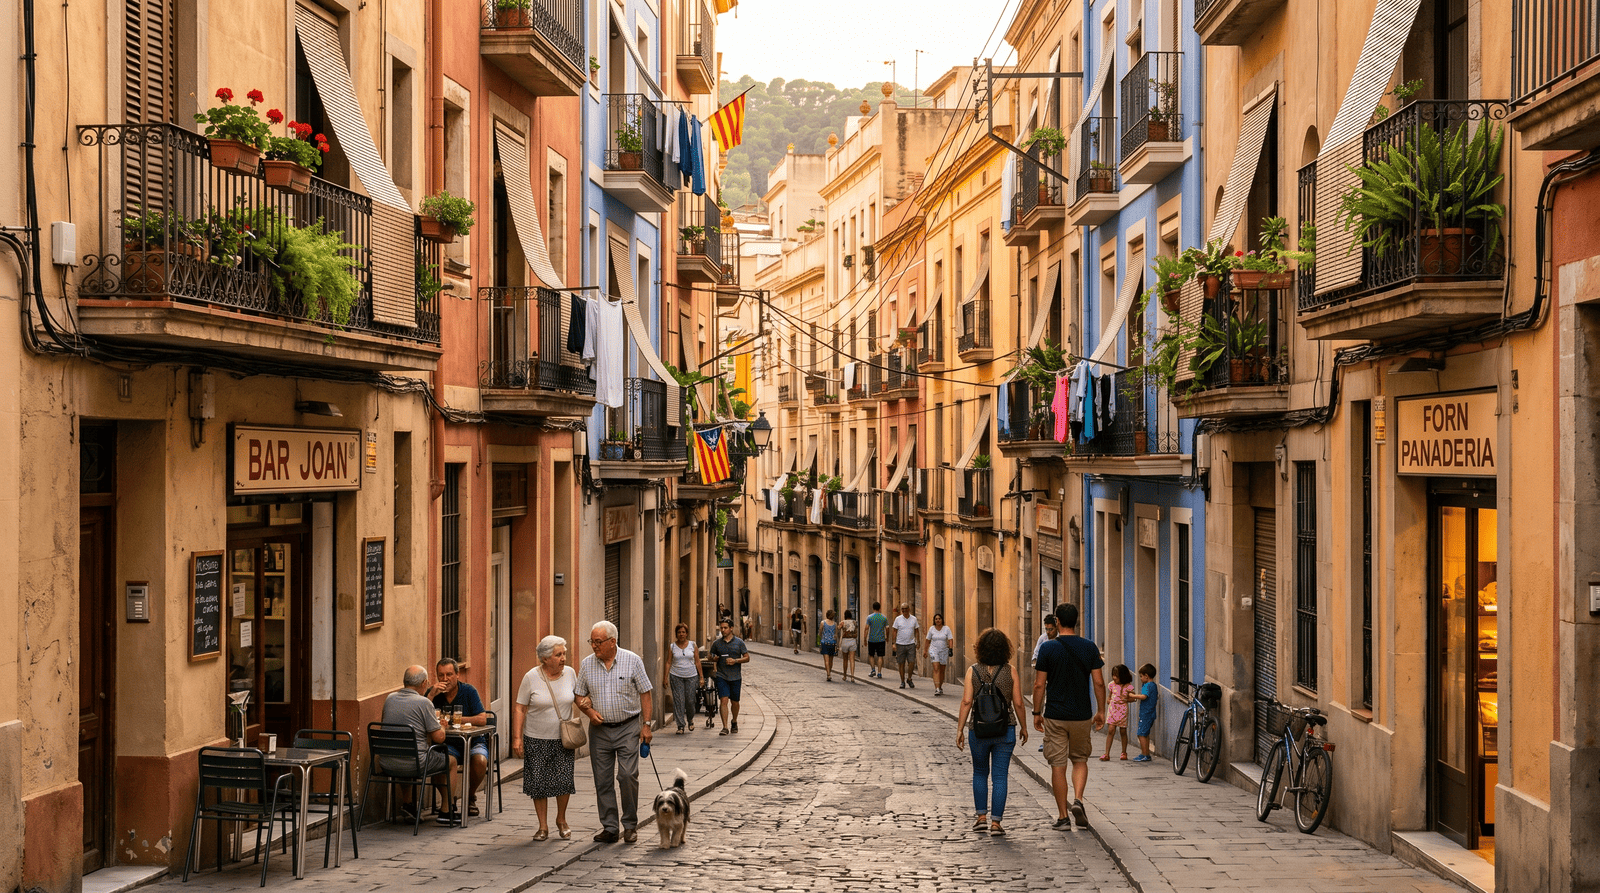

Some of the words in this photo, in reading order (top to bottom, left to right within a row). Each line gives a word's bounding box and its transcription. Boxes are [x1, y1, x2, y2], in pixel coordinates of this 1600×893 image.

[1423, 402, 1469, 432] FORN
[248, 438, 290, 481] BAR
[299, 440, 348, 481] JOAN
[1401, 437, 1494, 467] PANADERIA
